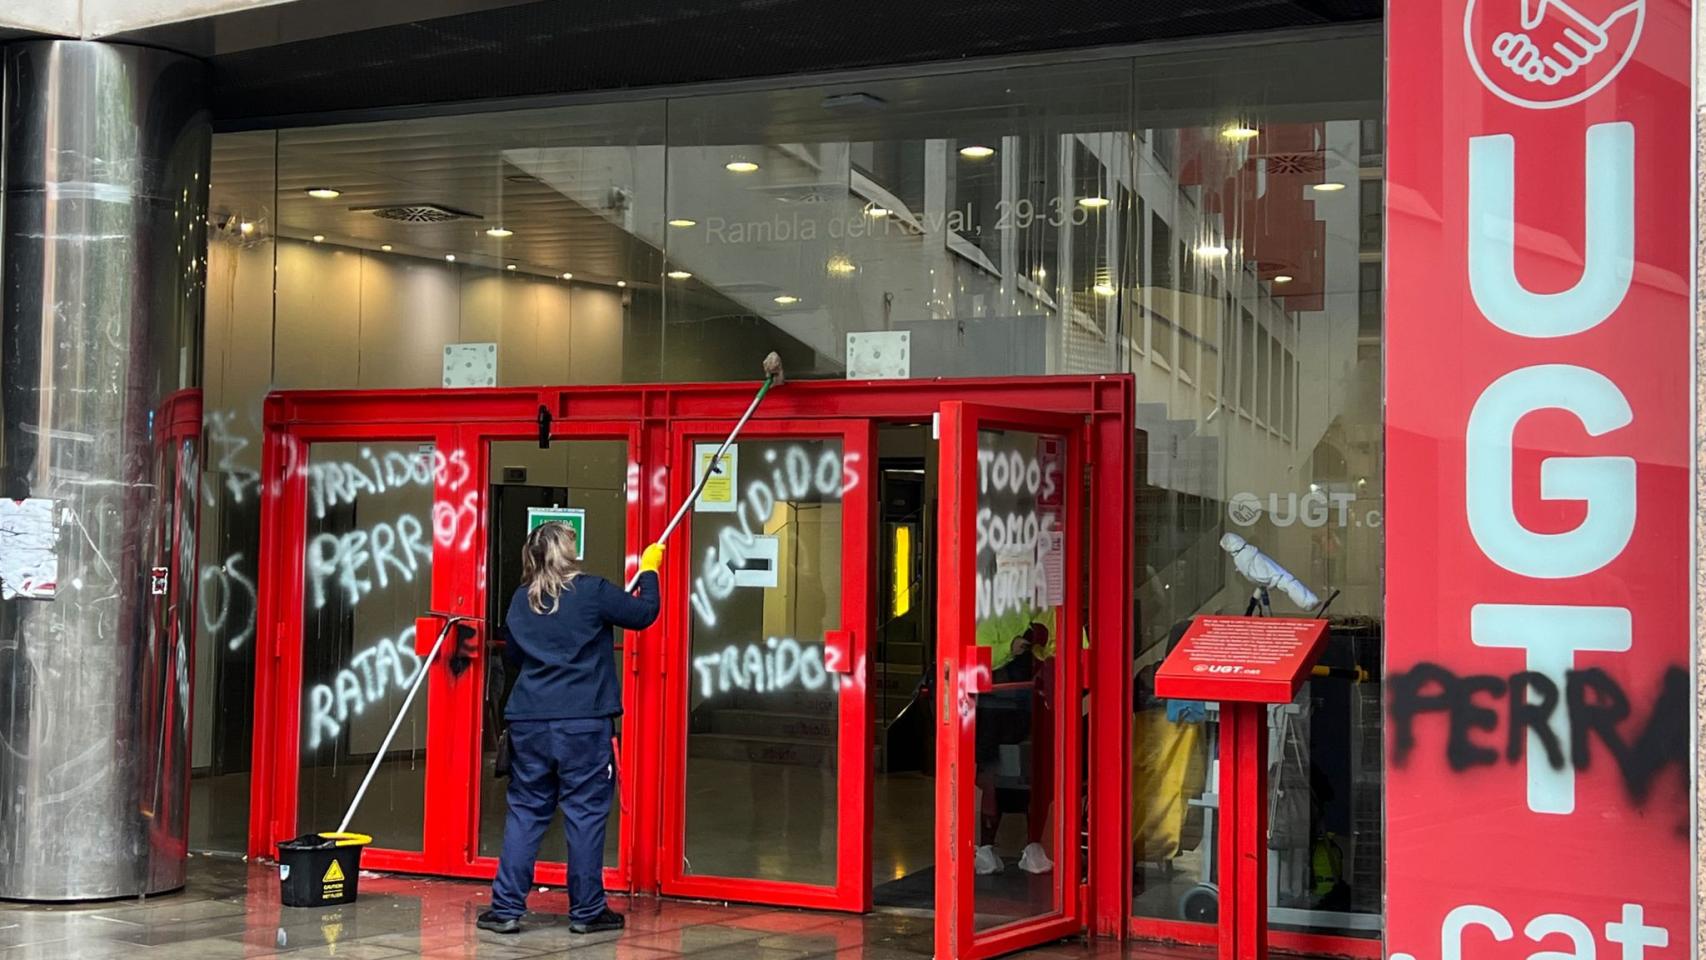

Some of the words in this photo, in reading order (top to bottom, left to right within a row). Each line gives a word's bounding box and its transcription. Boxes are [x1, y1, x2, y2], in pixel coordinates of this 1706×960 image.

[706, 211, 818, 246] Rambla
[831, 203, 873, 239] del
[884, 200, 983, 237] Raval,
[977, 449, 1057, 500] TODOS
[1466, 121, 1637, 816] UGT
[309, 625, 423, 750] RATAS
